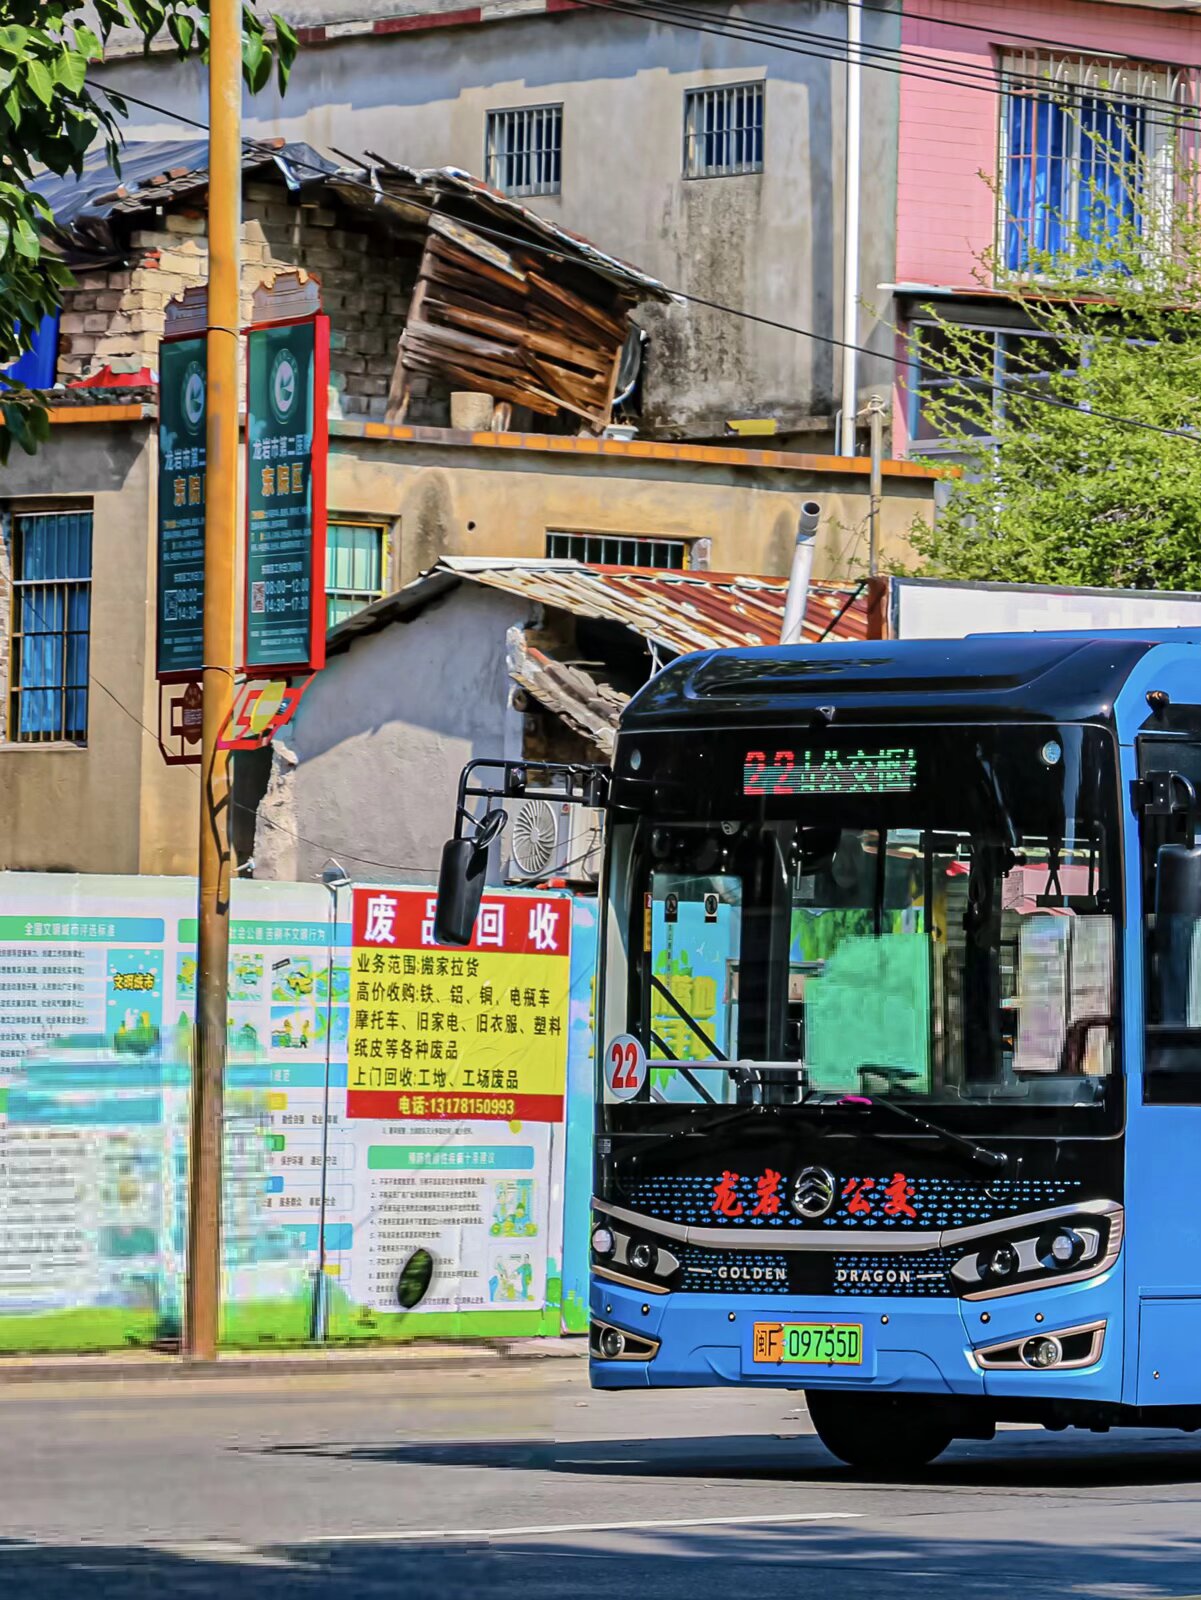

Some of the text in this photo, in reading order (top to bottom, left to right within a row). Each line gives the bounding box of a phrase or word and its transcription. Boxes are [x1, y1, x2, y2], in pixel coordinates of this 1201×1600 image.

[743, 751, 796, 795] 22
[353, 1038, 459, 1061] 纸皮等各种废品
[611, 1042, 639, 1089] 22
[717, 1266, 912, 1283] GOLDEN DRAGON
